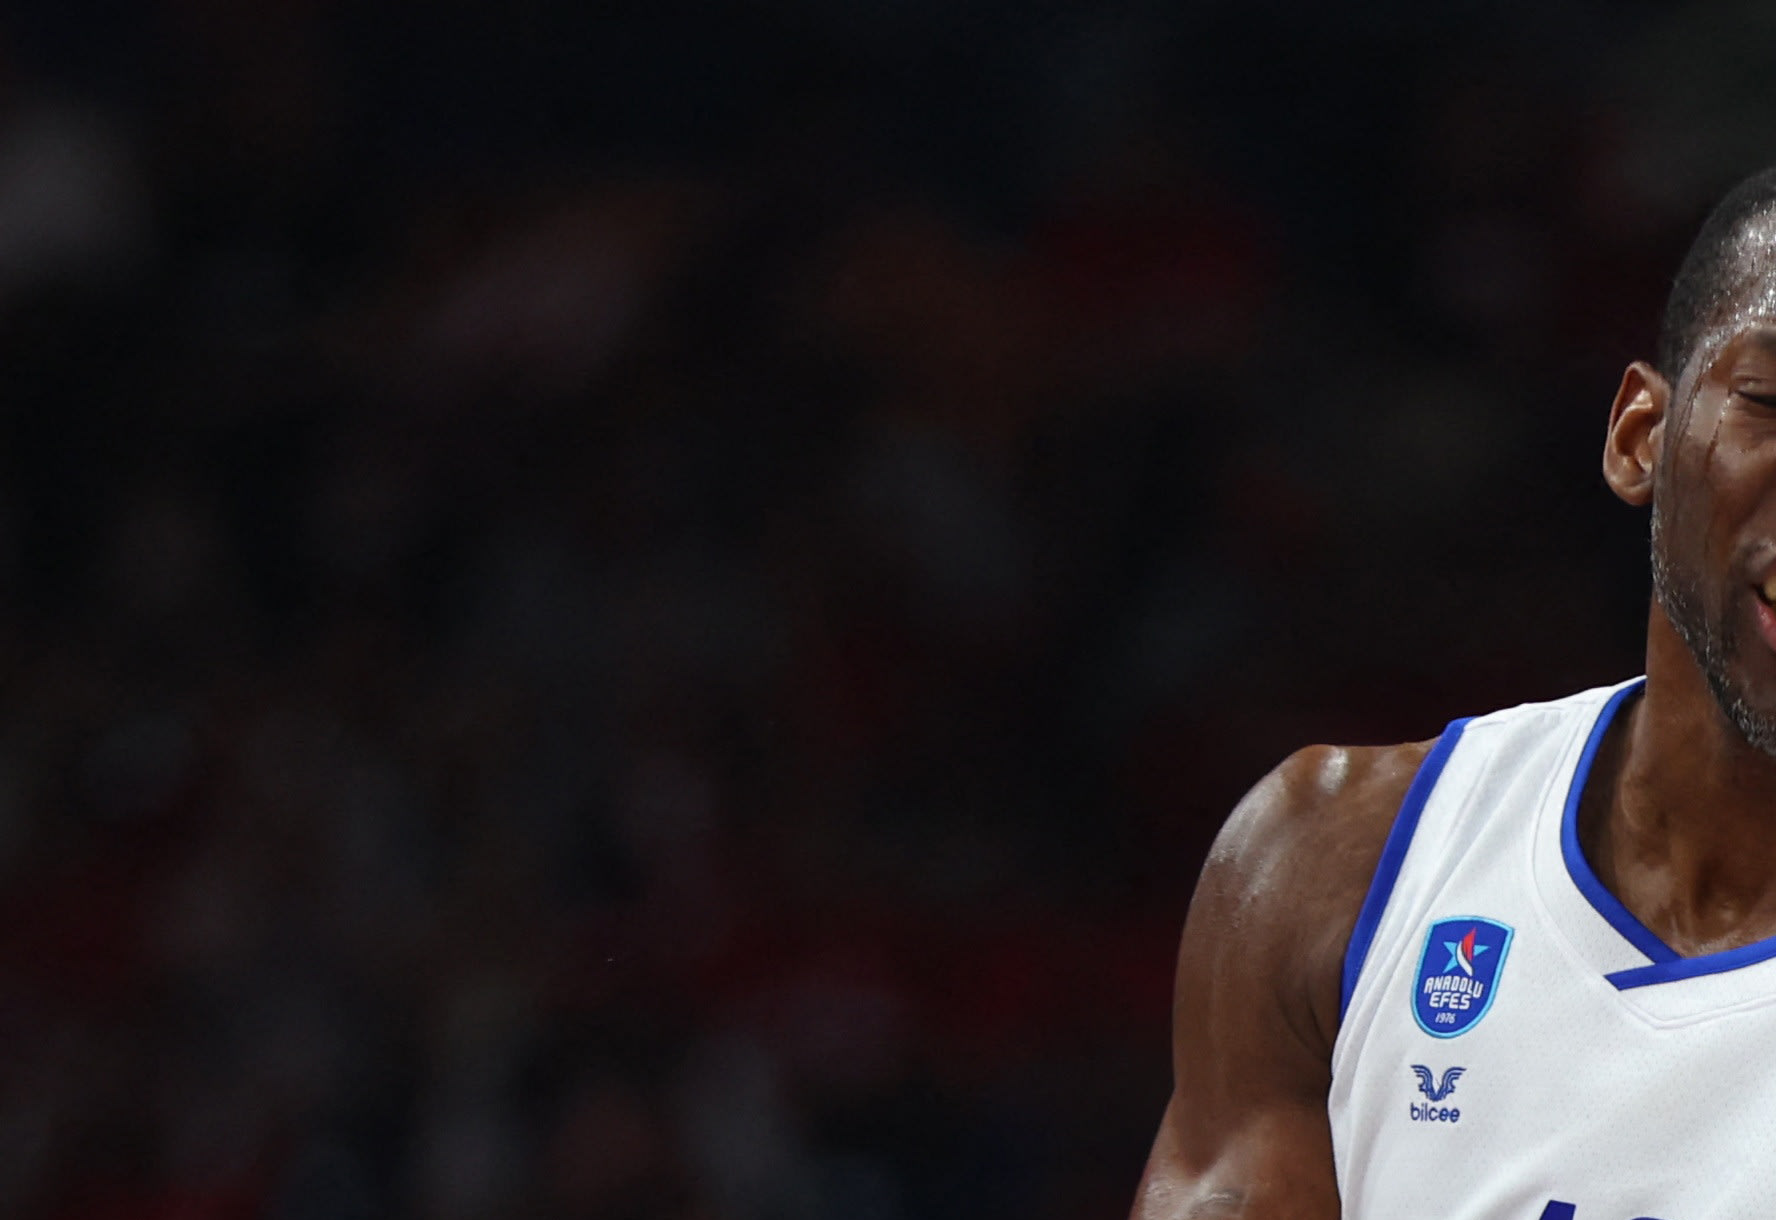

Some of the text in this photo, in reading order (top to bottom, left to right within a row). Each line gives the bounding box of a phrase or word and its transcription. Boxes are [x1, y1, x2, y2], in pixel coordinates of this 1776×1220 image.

[1424, 976, 1484, 998] ANADOLU
[1429, 992, 1471, 1010] EFES
[1435, 1012, 1456, 1024] 1976
[1410, 1103, 1460, 1123] bilcee
